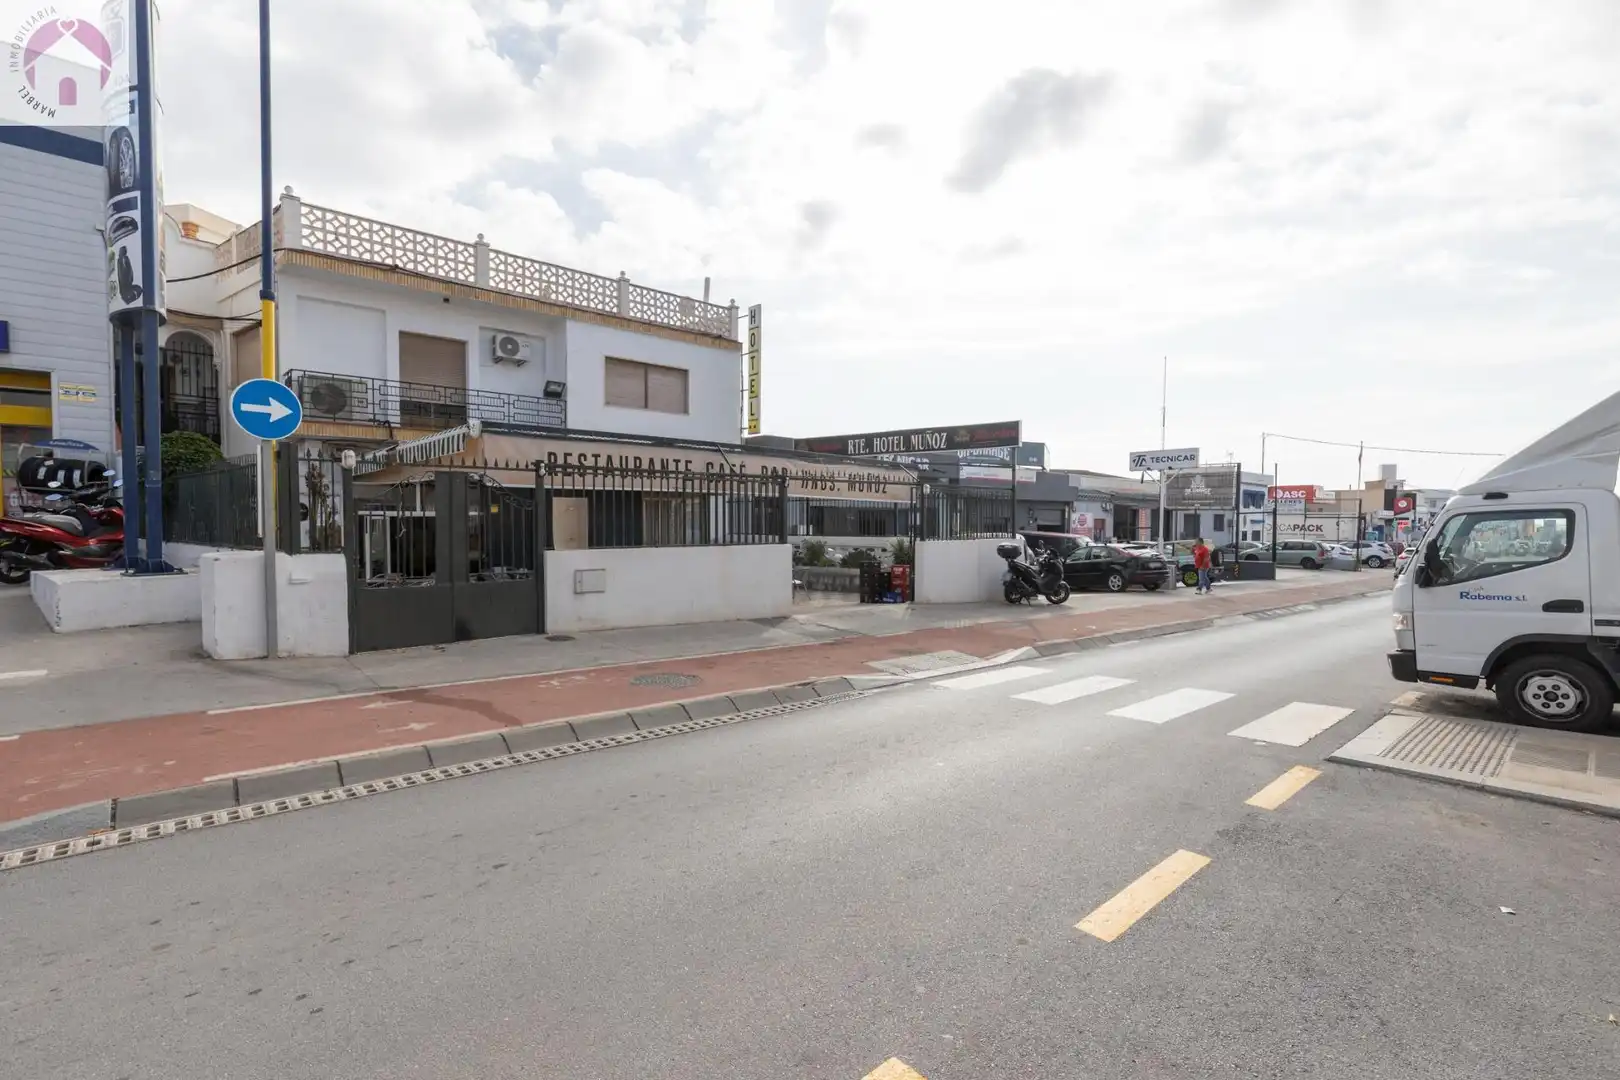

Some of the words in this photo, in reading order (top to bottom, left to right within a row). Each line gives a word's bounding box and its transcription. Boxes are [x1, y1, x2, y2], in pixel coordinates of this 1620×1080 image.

[873, 436, 905, 453] HOTEL
[911, 430, 947, 450] MUÑOZ
[547, 451, 693, 480] RESTAURANTE
[1151, 454, 1196, 463] TECNICAR
